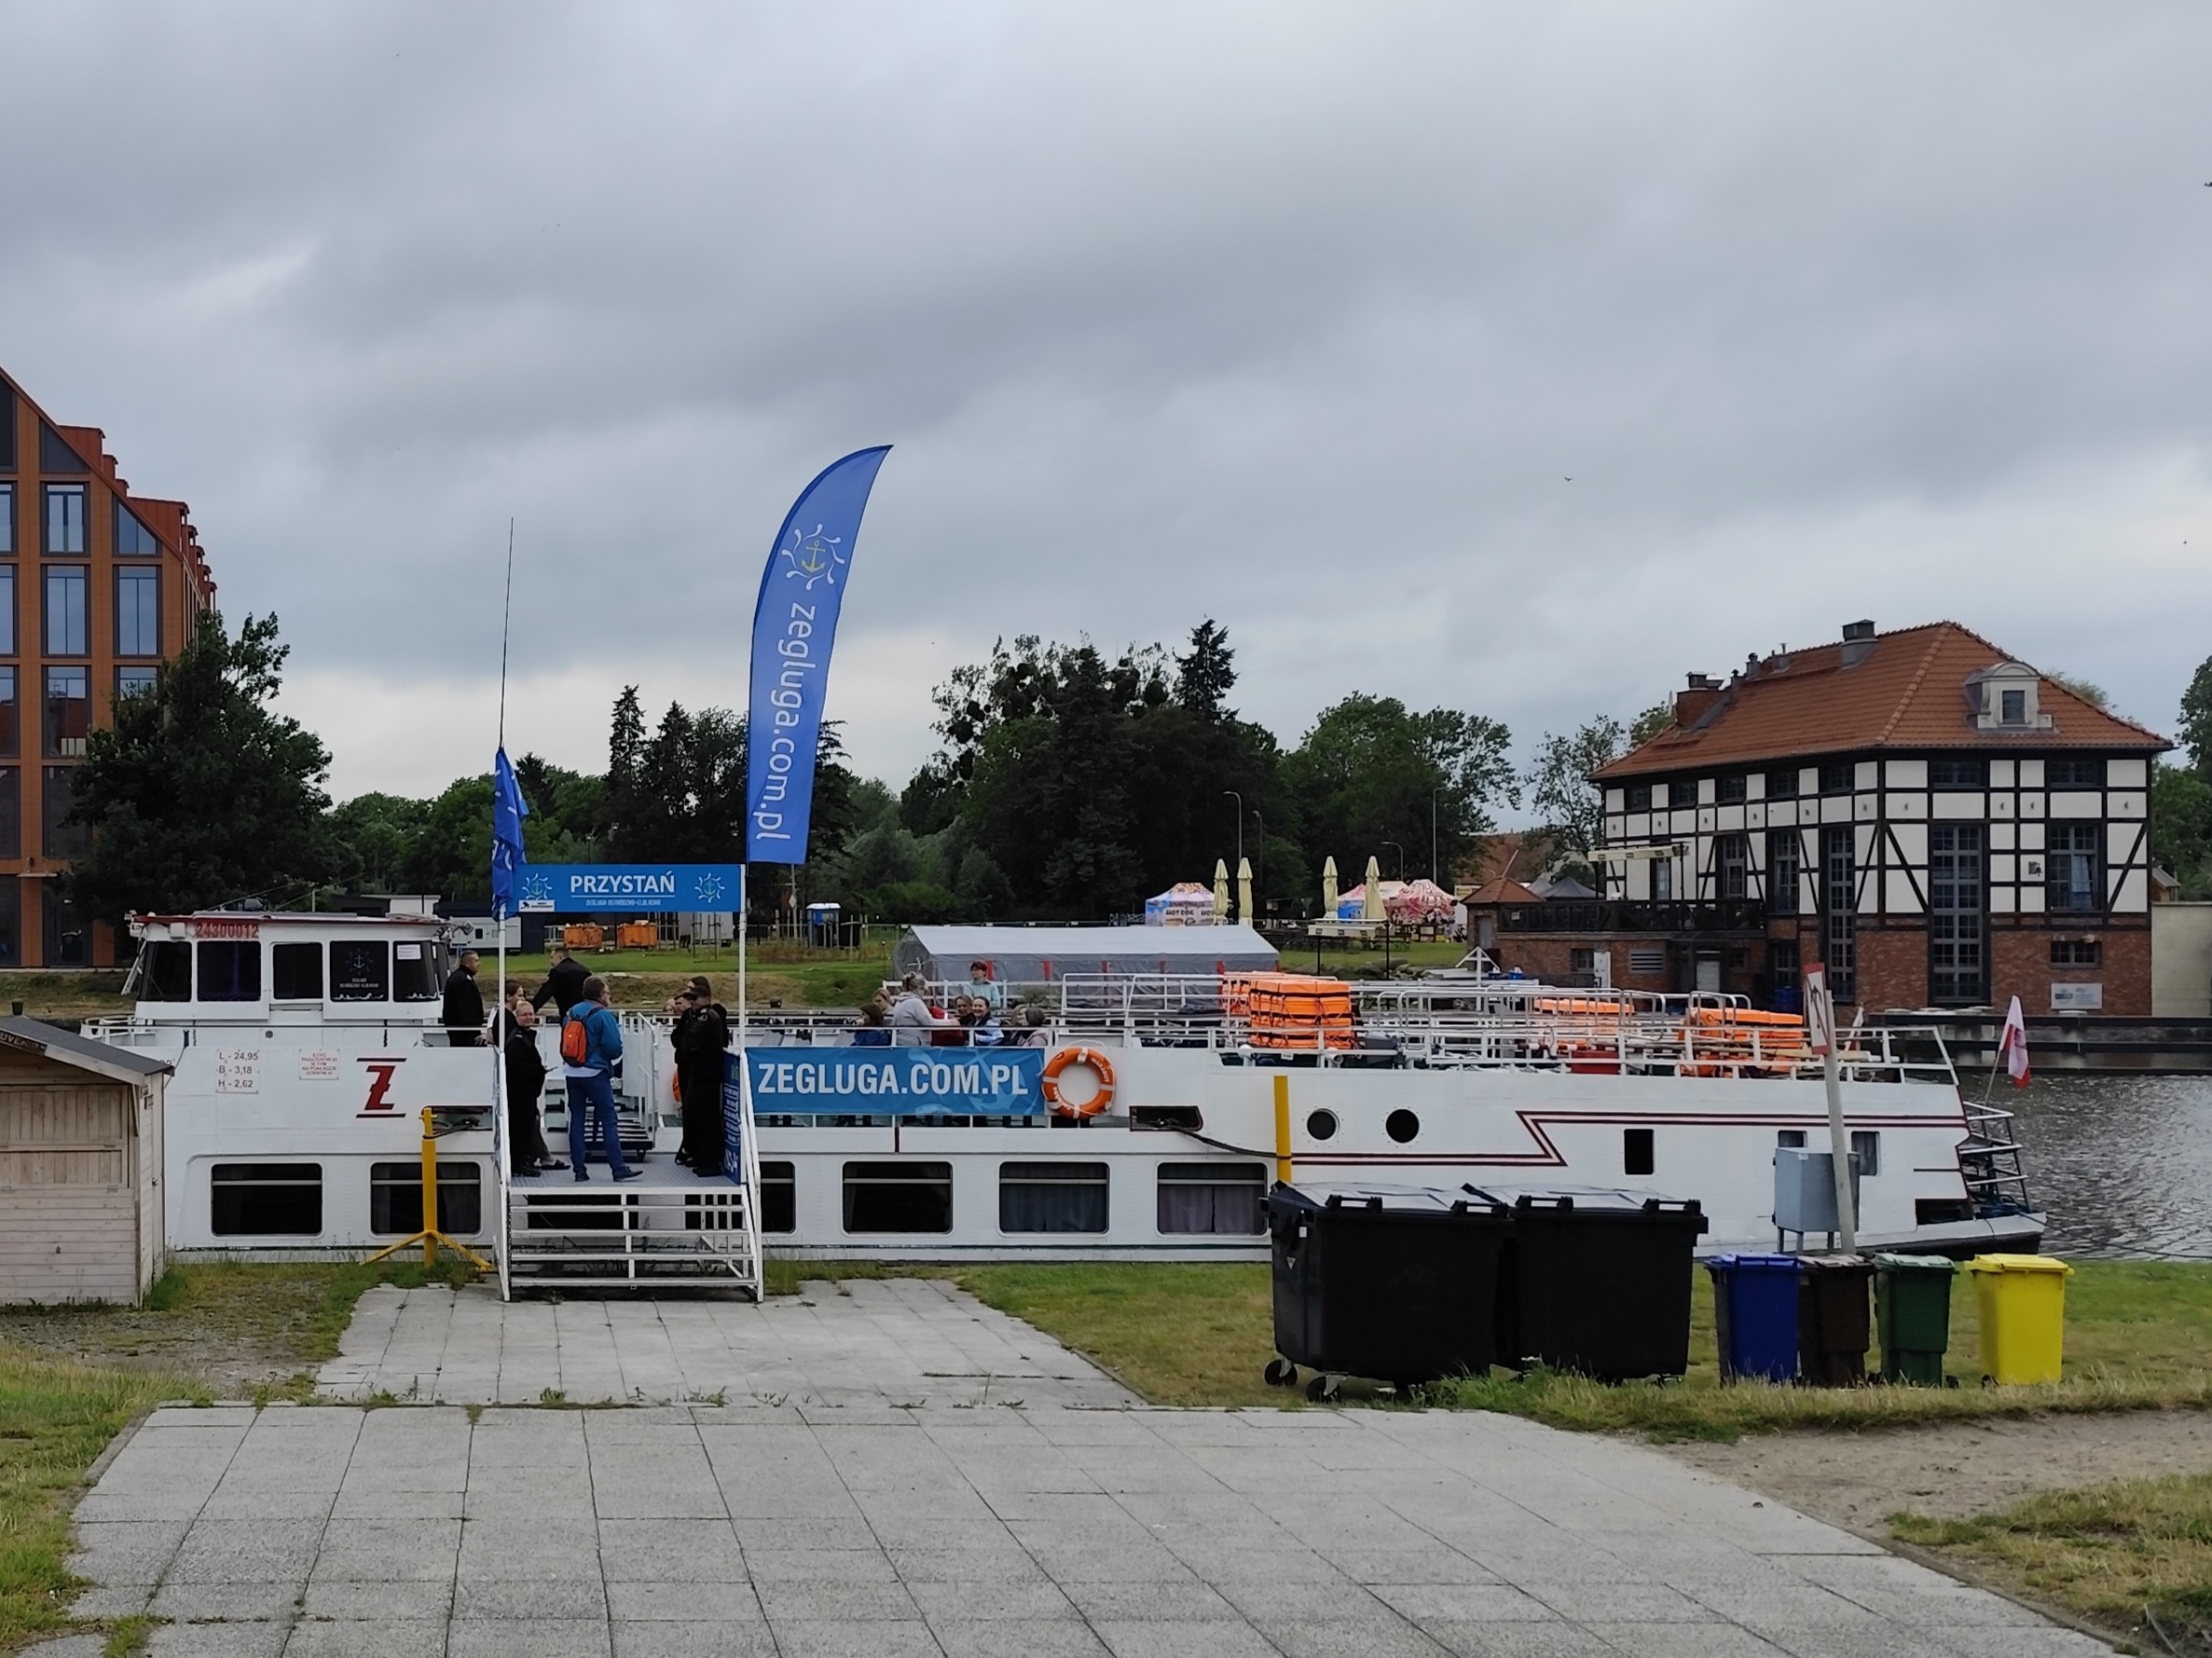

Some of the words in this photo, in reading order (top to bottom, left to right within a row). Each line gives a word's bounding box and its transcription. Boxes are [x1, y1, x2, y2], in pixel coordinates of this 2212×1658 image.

[752, 602, 817, 840] zegluga.com.pl
[570, 870, 675, 893] PRZYSTAŃ
[195, 924, 259, 939] 24300012
[234, 1052, 258, 1062] 24,95
[234, 1065, 252, 1075] 3,18
[758, 1062, 1028, 1095] ZEGLUGA.COM.PL
